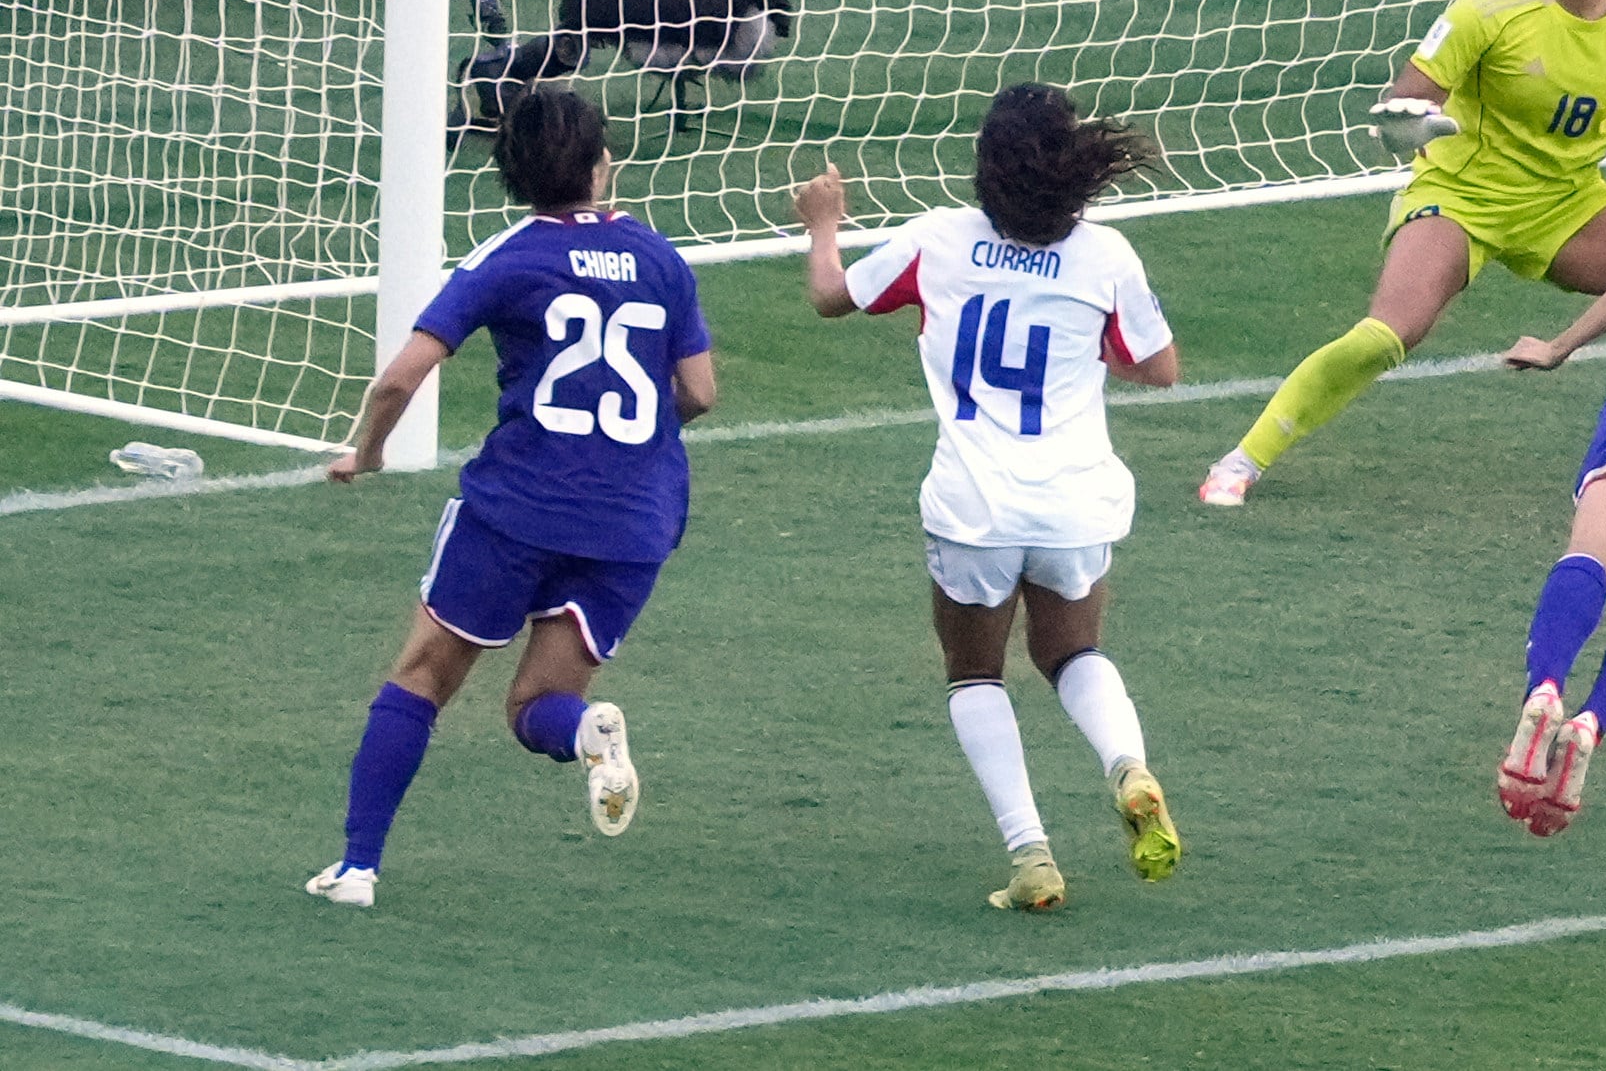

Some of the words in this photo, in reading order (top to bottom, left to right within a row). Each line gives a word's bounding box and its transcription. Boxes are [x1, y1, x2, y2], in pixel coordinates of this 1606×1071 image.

[1546, 93, 1599, 139] 18
[568, 249, 638, 282] CHIBA
[971, 240, 1062, 279] CURRAN
[533, 292, 667, 445] 25
[951, 293, 1051, 436] 14
